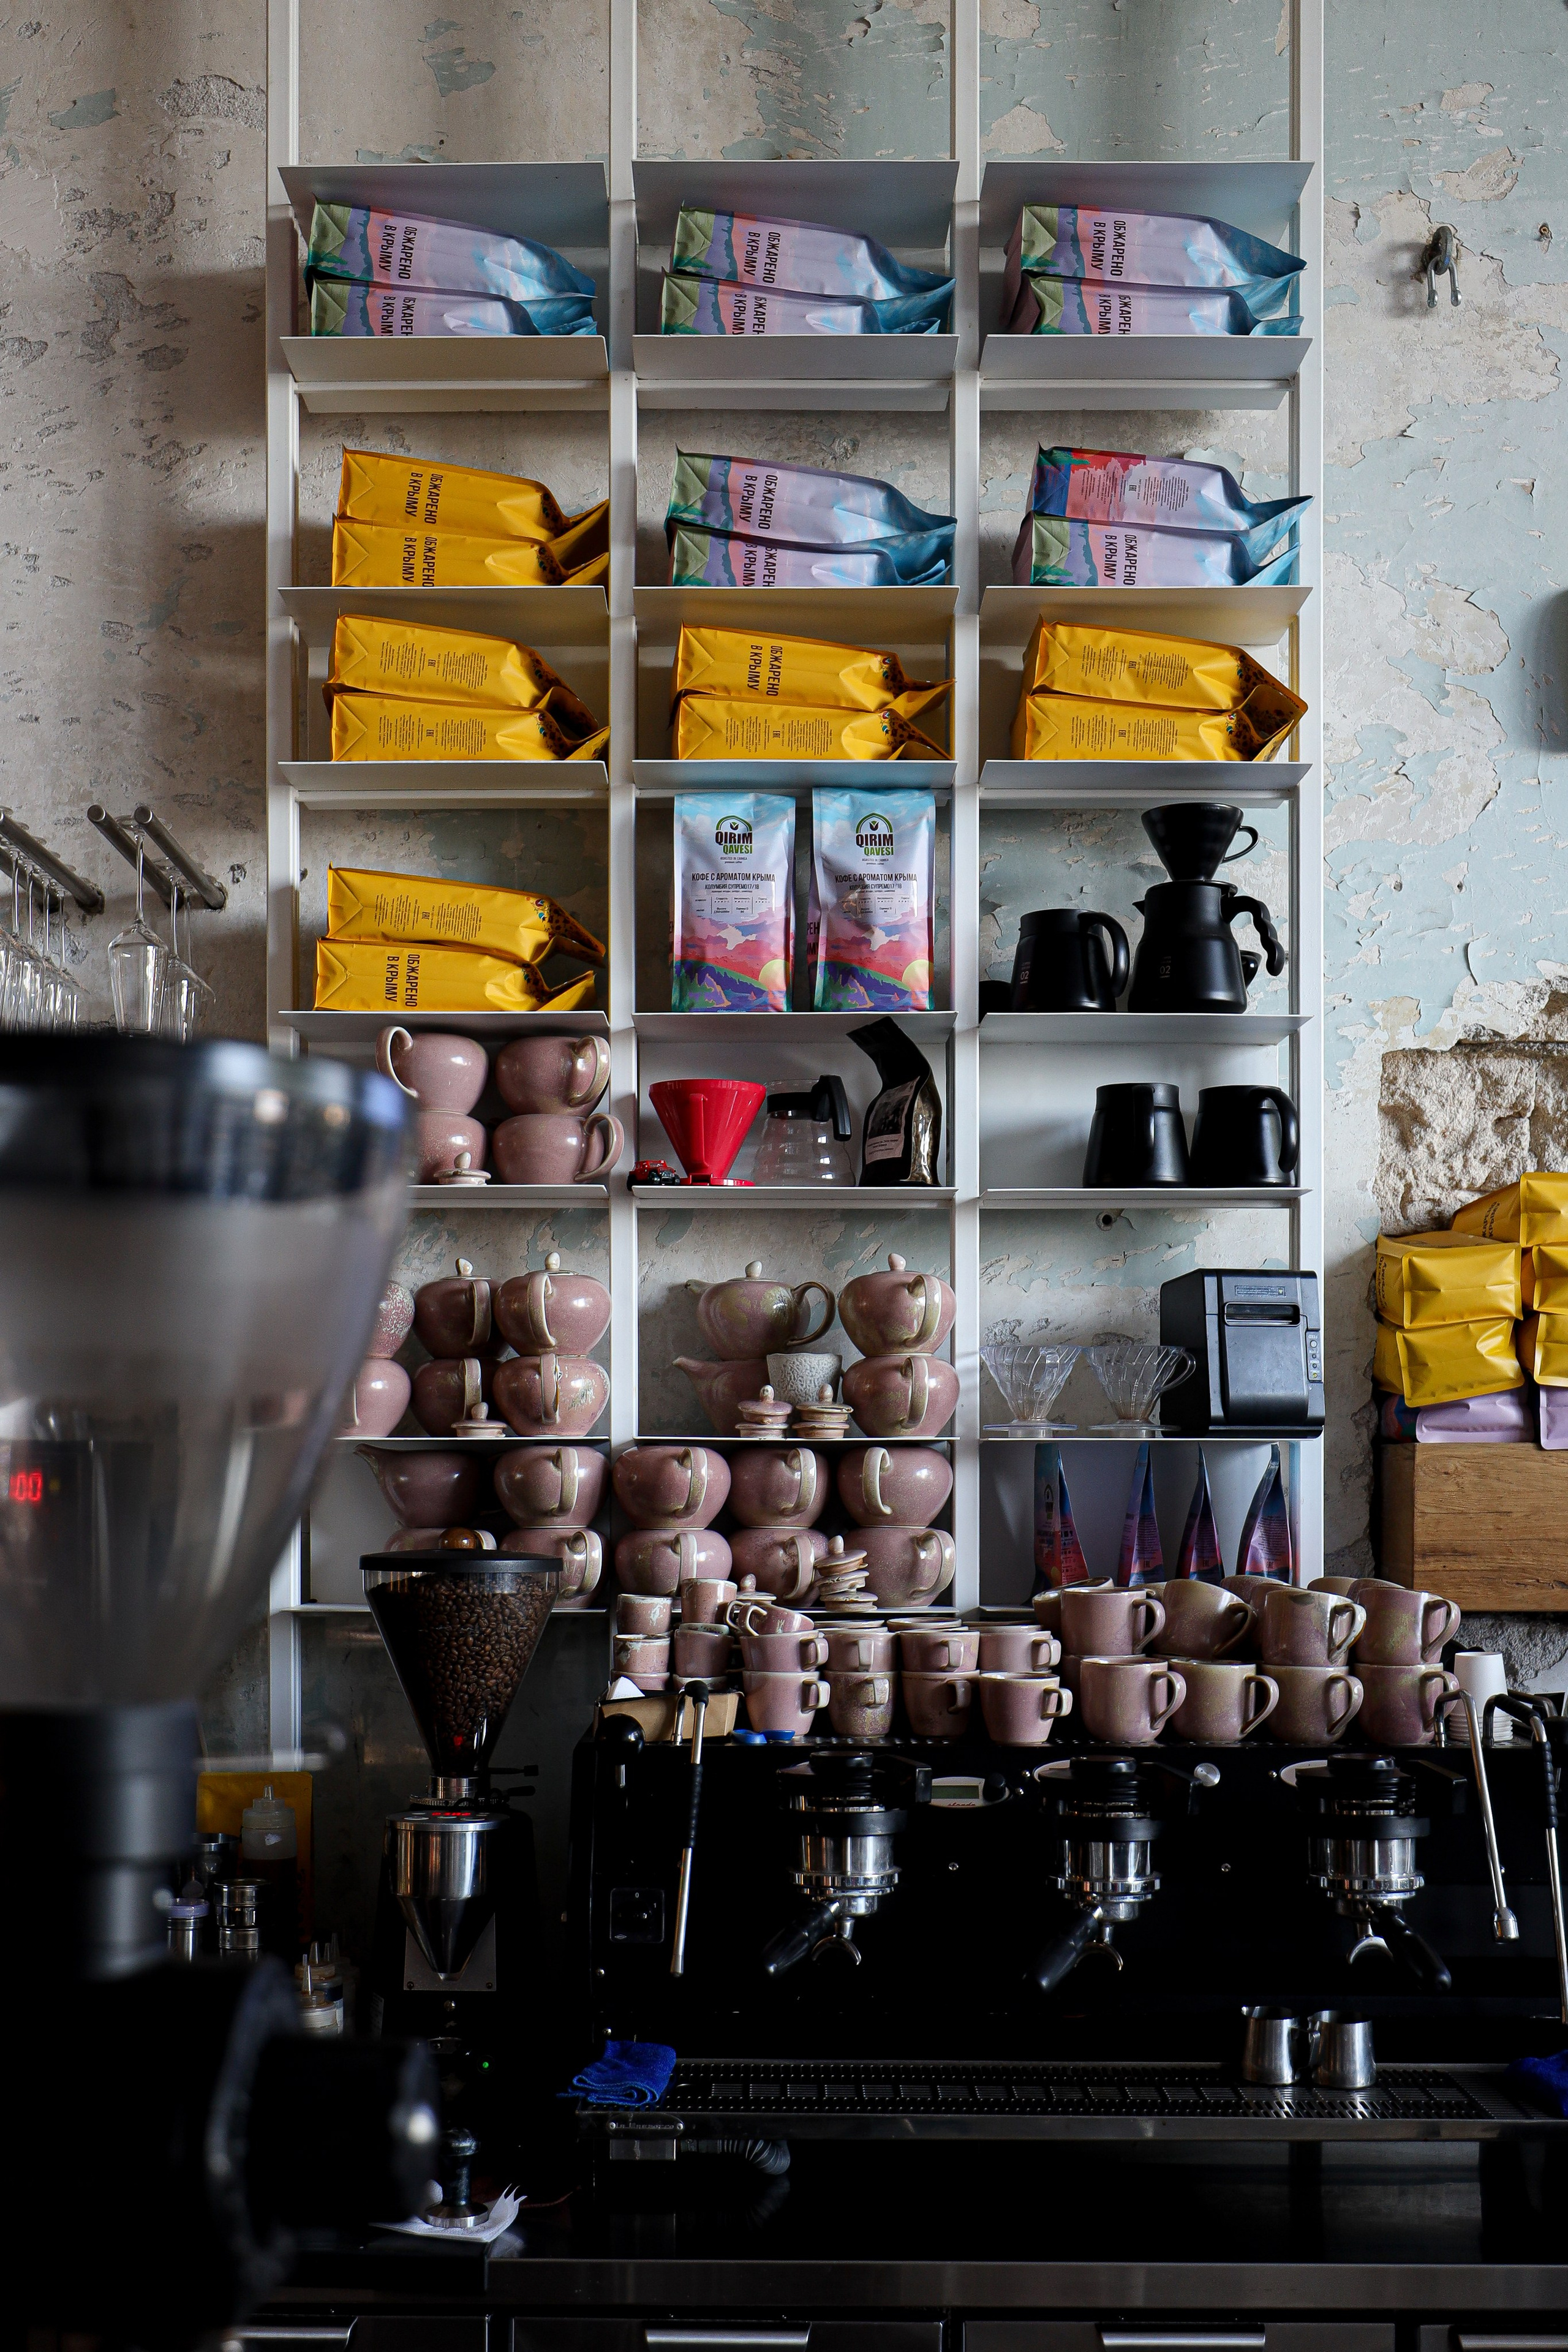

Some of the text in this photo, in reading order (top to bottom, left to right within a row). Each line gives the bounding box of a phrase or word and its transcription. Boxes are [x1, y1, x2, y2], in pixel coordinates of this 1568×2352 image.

[379, 232, 396, 272] КРЫМУ
[398, 226, 418, 280] ОБЖАРЕНО
[743, 238, 760, 276] КРЫМУ
[762, 232, 781, 284] ОБЖАРЕНО
[1091, 229, 1106, 270] КРЫМУ
[1110, 220, 1126, 276] ОБЖАРЕНО
[380, 302, 395, 336] КРЫМ
[405, 478, 422, 518] КРЫМУ
[424, 473, 443, 524] ОБЖАРЕНО
[739, 482, 756, 523] КРЫМУ
[758, 474, 778, 530] ОБЖАРЕНО
[402, 544, 417, 582] КРЫМУ
[422, 537, 437, 587] ОБЖАРЕНО
[1104, 542, 1117, 580] КРЫМУ
[1123, 534, 1137, 586] ОБЖАРЕНО
[747, 651, 763, 691] КРЫМУ
[766, 645, 783, 696] ОБЖАРЕНО
[715, 831, 753, 846] QIRIM
[723, 844, 753, 854] QAVESI
[856, 834, 894, 848] QIRIM
[864, 846, 894, 856] QAVESI
[716, 872, 751, 881] АРОМАТОМ
[752, 873, 775, 882] КРЫМА
[835, 874, 853, 883] КОФЕ
[858, 873, 893, 881] АРОМАТОМ
[894, 873, 917, 881] КРЫМА
[385, 963, 399, 1003] КРЫМУ
[405, 954, 421, 1007] ОБЖАРЕНО
[1020, 971, 1029, 980] 02
[1159, 965, 1170, 974] 02
